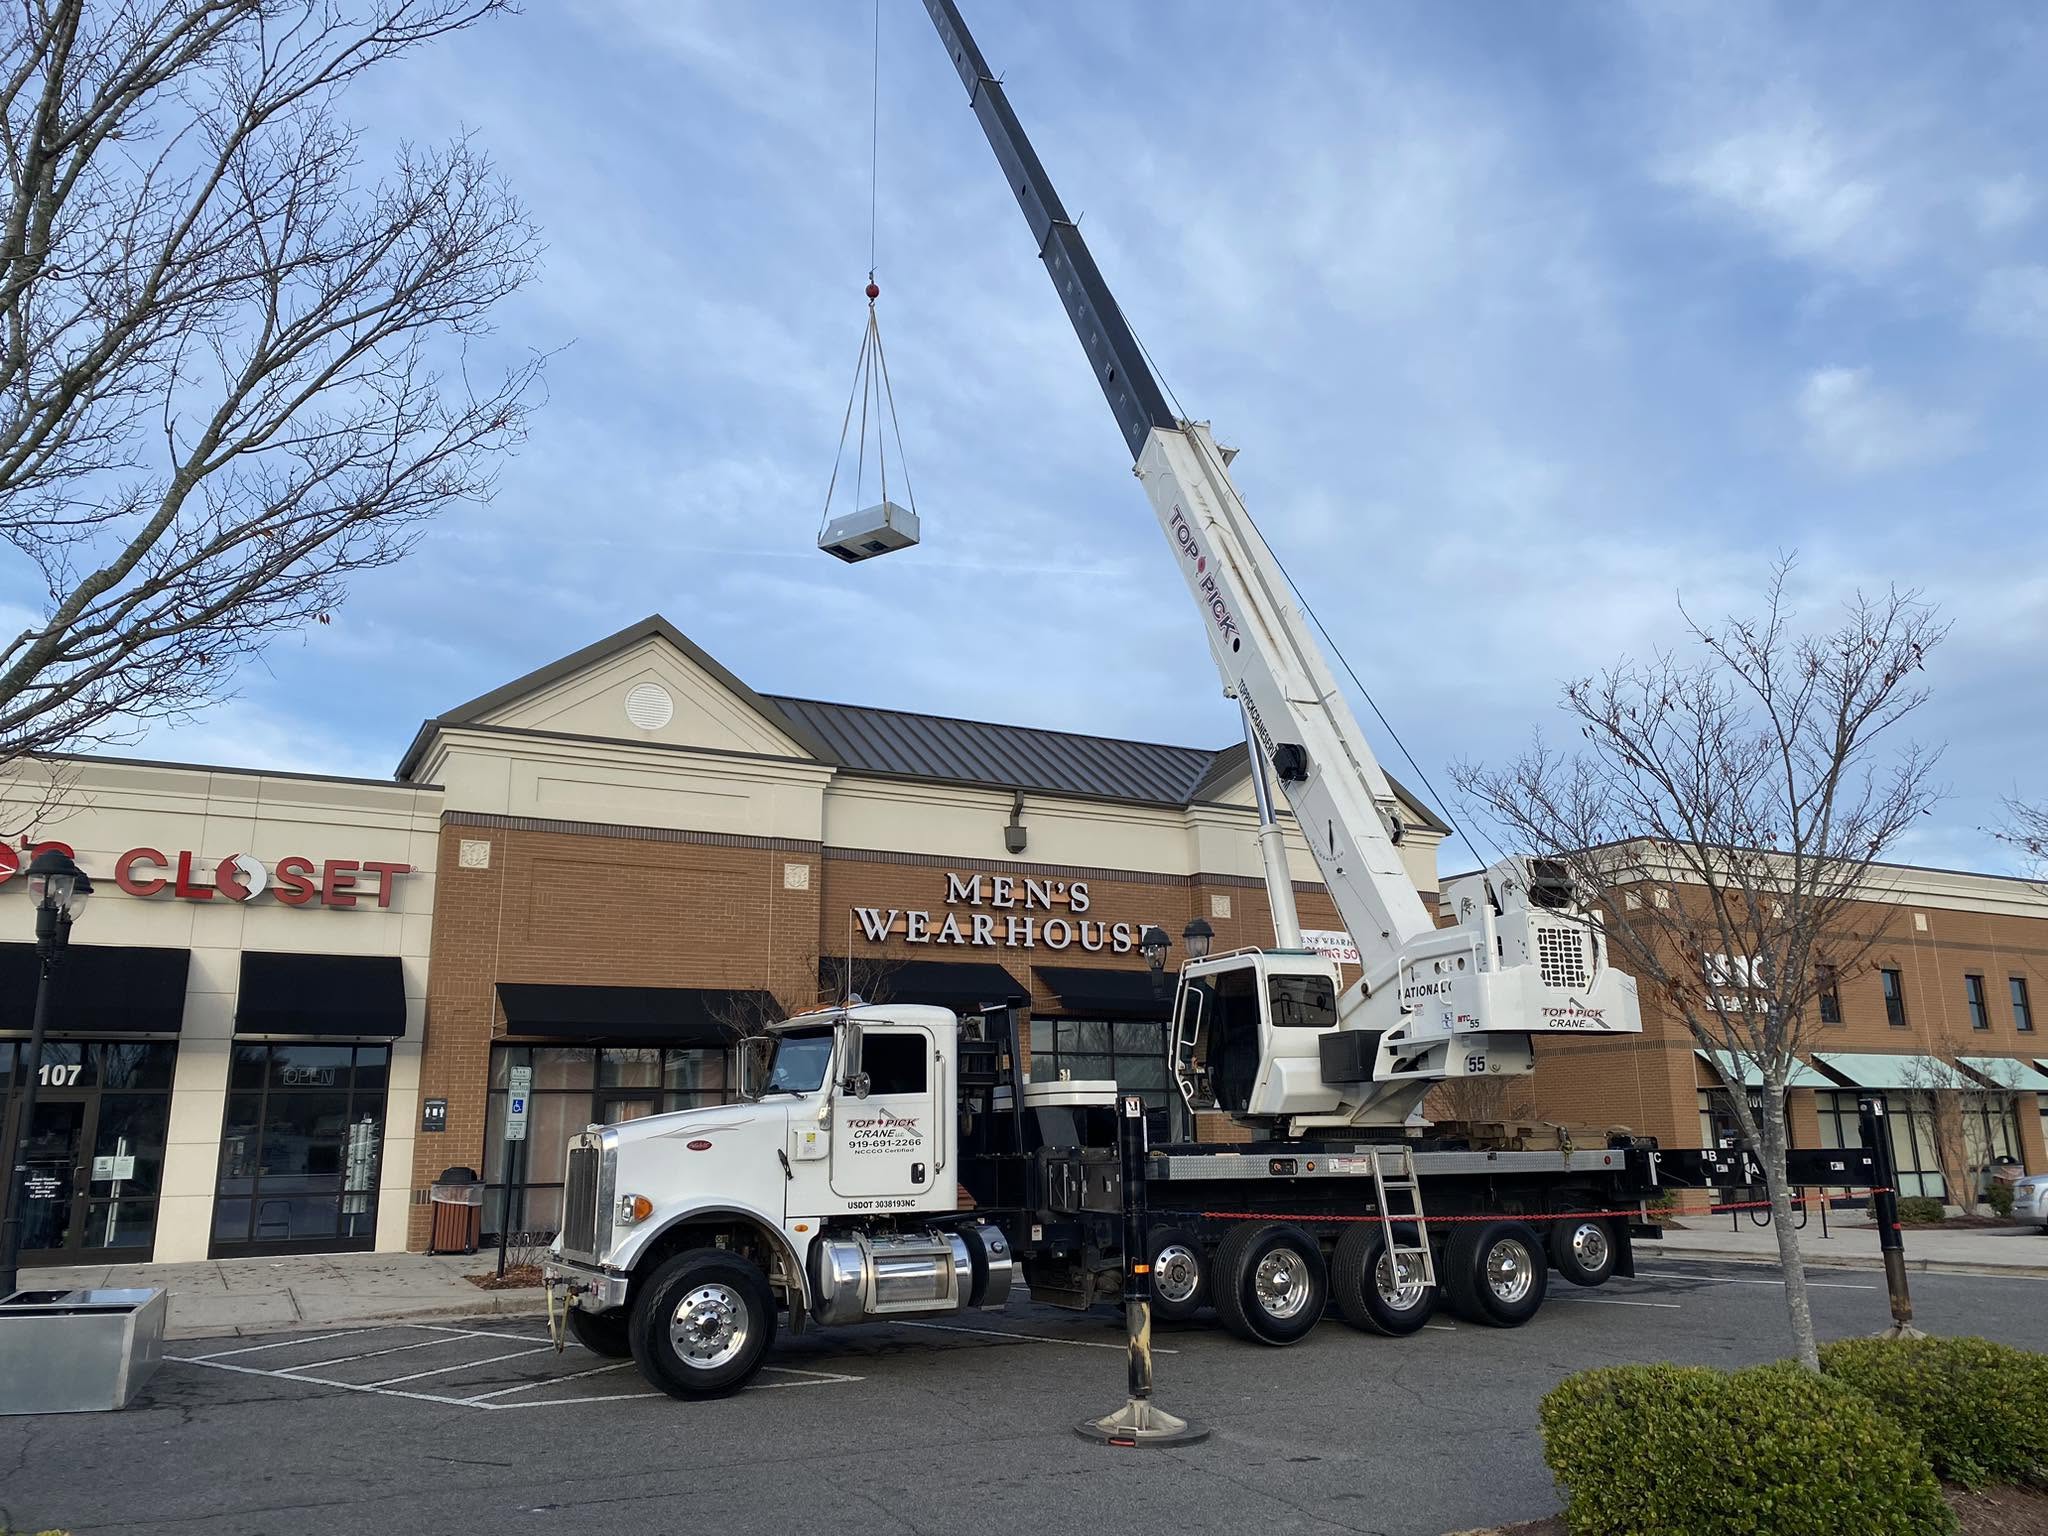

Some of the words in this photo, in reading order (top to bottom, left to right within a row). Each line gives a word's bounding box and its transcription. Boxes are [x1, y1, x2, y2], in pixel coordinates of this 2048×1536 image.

[1170, 504, 1200, 560] TOP
[1200, 572, 1240, 644] PICK
[946, 872, 1090, 912] MEN'S
[1301, 936, 1319, 944] EN'S
[1322, 937, 1353, 947] WEARH
[1344, 948, 1358, 960] SO
[1541, 1008, 1567, 1017] TOP
[1576, 1009, 1606, 1018] PICK
[1470, 1019, 1480, 1029] 55
[1549, 1018, 1586, 1028] CRANE
[1468, 1056, 1486, 1073] 55
[38, 1064, 82, 1086] 107
[847, 1118, 875, 1128] TOP
[885, 1117, 919, 1128] PICK
[853, 1129, 896, 1138] CRANE
[848, 1138, 922, 1149] 919-691-2266
[1654, 1151, 1662, 1163] C
[1708, 1150, 1717, 1162] B
[1750, 1162, 1760, 1175] A
[847, 1201, 874, 1209] USDOT
[875, 1199, 916, 1209] 3038193NC
